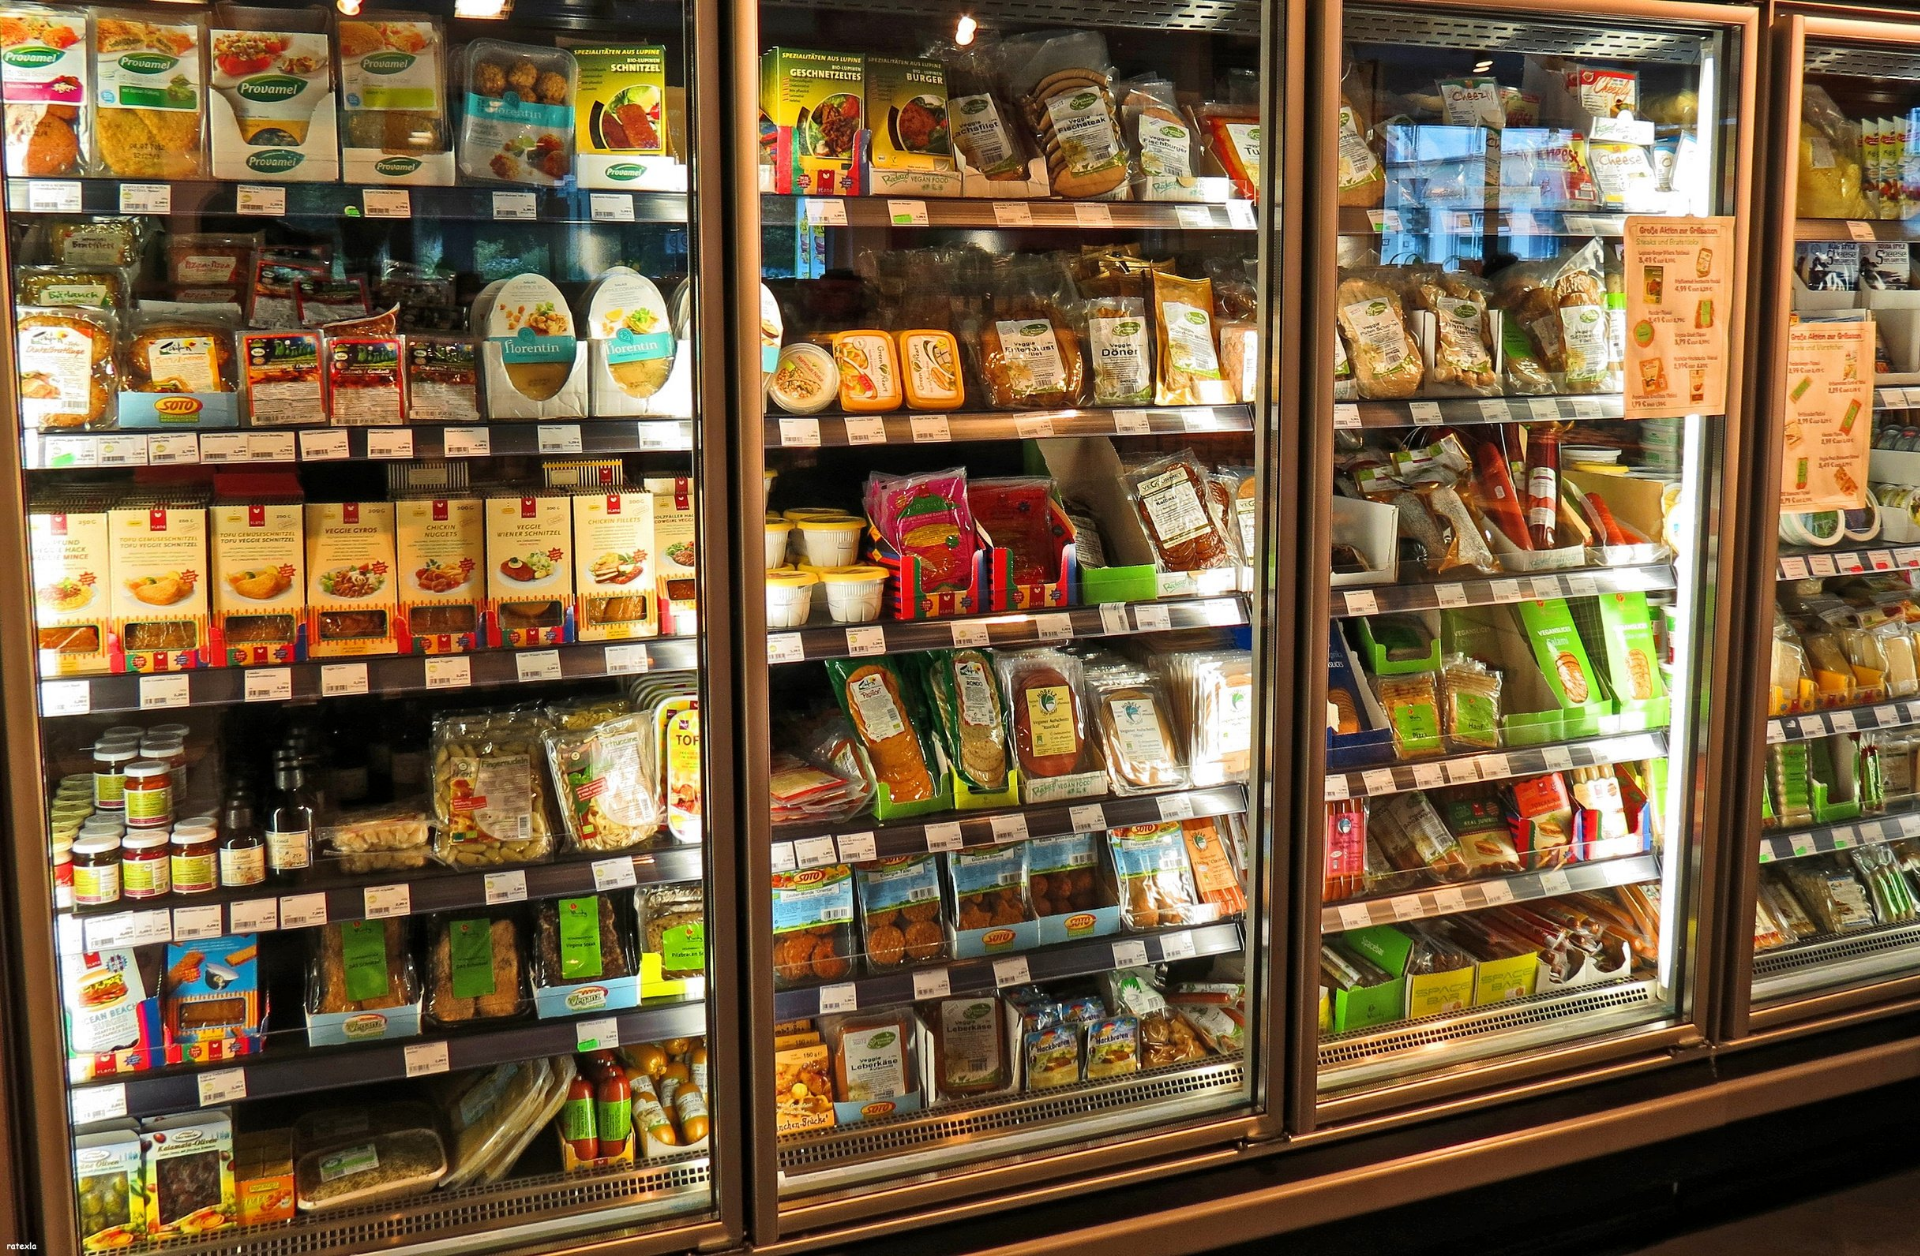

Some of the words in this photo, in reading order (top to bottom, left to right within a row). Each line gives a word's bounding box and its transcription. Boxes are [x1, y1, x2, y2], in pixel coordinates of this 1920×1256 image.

[4, 52, 57, 63] Provamel
[120, 56, 170, 70] Provamel
[782, 52, 826, 62] SPEZIALITÄTEN
[362, 57, 409, 71] Provamel
[610, 63, 661, 73] SCHNITZEL
[789, 67, 862, 81] GESCHNETZELTES
[906, 73, 944, 85] BURGER
[240, 82, 298, 97] Provamel
[249, 155, 297, 168] Provamel
[1599, 153, 1644, 166] Cheese
[376, 159, 417, 173] Provamel
[606, 167, 643, 178] Provamel
[504, 339, 560, 354] florentin
[605, 338, 658, 355] florentin
[1101, 347, 1139, 358] Döner
[877, 345, 885, 364] Green
[162, 400, 194, 411] SOTO
[325, 527, 352, 535] VEGGIE
[353, 526, 378, 534] GYROS
[426, 524, 456, 532] CHICKIN
[516, 523, 542, 531] VEGGIE
[138, 535, 198, 543] GEMÜSESCHNITZEL
[424, 530, 458, 539] NUGGETS
[497, 530, 524, 538] WIENER
[525, 530, 562, 538] SCHNITZEL
[1136, 823, 1154, 834] SOTO
[797, 871, 823, 883] SOTO
[1069, 916, 1091, 928] SOTO
[988, 932, 1009, 943] SOTO
[1481, 967, 1534, 984] SPACE
[1415, 981, 1471, 999] SPACE
[1491, 978, 1523, 993] BAR
[1426, 992, 1460, 1008] BAR
[946, 1023, 992, 1033] Leberkäse
[850, 1058, 898, 1071] Leberkäse
[859, 1055, 882, 1063] Veggie
[866, 1103, 890, 1114] SOTO
